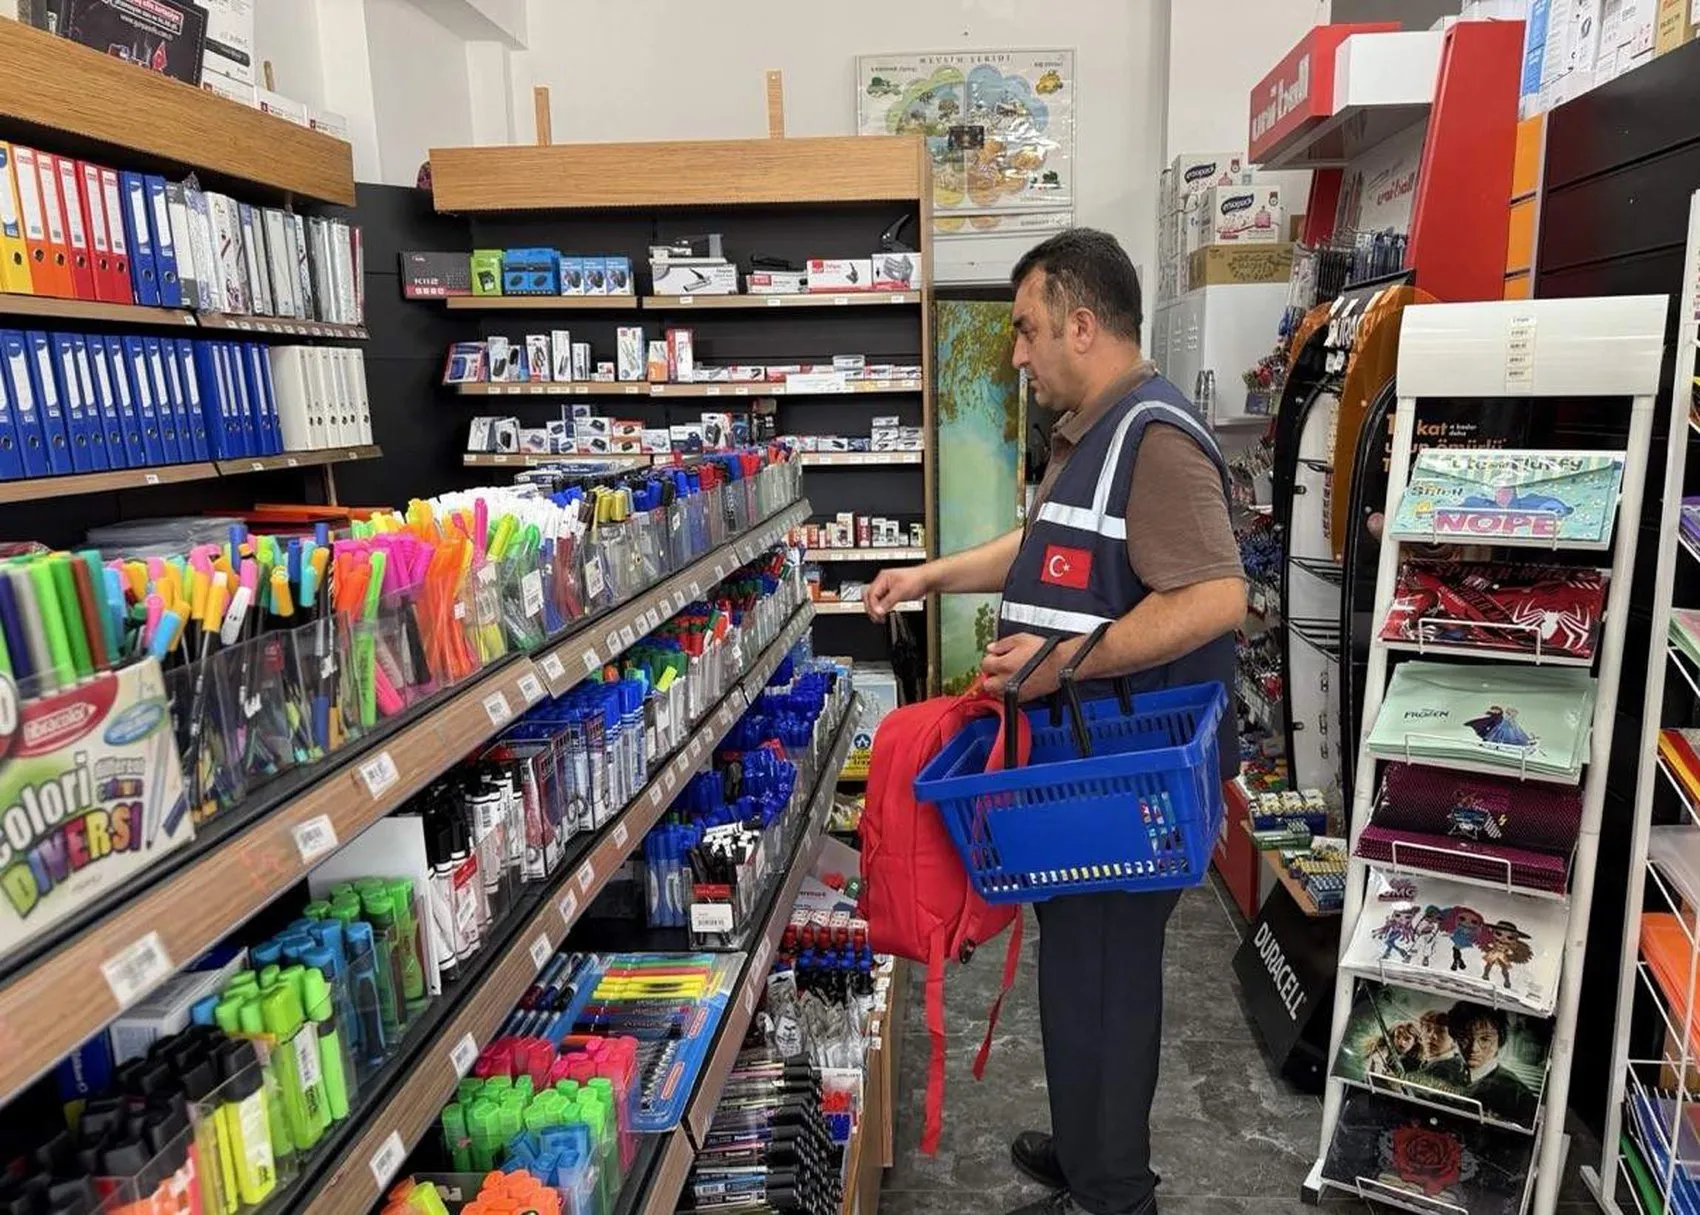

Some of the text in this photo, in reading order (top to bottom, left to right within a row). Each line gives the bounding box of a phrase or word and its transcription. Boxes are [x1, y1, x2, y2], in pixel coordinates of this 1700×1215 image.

[1416, 419, 1449, 435] kat
[1435, 509, 1561, 536] NOPE
[1404, 709, 1450, 719] FROZEN
[0, 801, 144, 919] DIVERSI
[1254, 922, 1305, 1020] DURACELL
